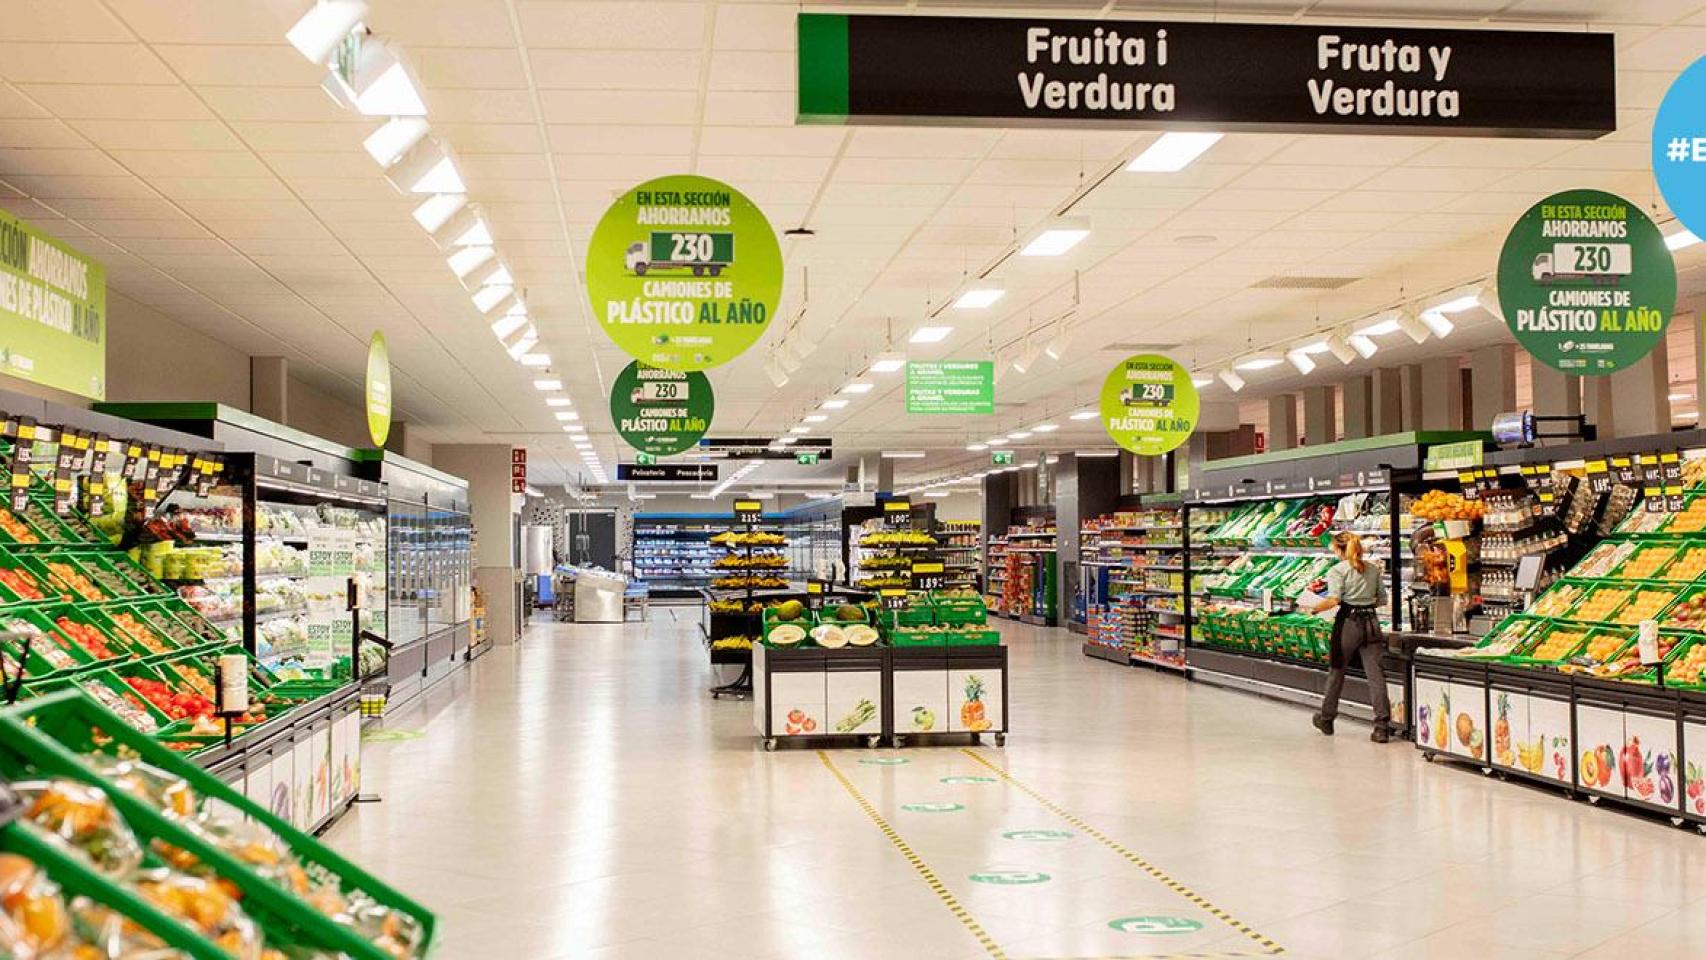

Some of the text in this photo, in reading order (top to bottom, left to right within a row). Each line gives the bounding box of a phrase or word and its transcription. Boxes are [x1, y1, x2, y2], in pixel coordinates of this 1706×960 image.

[1027, 27, 1167, 66] Fruita i
[1318, 35, 1452, 81] Fruta y
[1017, 72, 1175, 112] Verdura
[1307, 79, 1459, 117] Verdura
[637, 190, 731, 206] EN ESTA SECCIÓN
[637, 207, 731, 225] AHORRAMOS
[1541, 204, 1626, 219] EN ESTA SECCIÓN
[1542, 221, 1627, 238] AHORRAMOS
[671, 234, 714, 261] 230
[1574, 246, 1611, 271] 230
[643, 281, 732, 298] CAMIONES DE
[1550, 291, 1631, 307] CAMIONES DE
[607, 298, 766, 324] PLÁSTICO AL AÑO
[1516, 306, 1662, 331] PLÁSTICO AL AÑO
[656, 384, 677, 397] 230
[1143, 384, 1165, 399] 230
[621, 416, 706, 431] PLÁSTICO AL AÑO
[1110, 417, 1191, 432] PLÁSTICO AL AÑO
